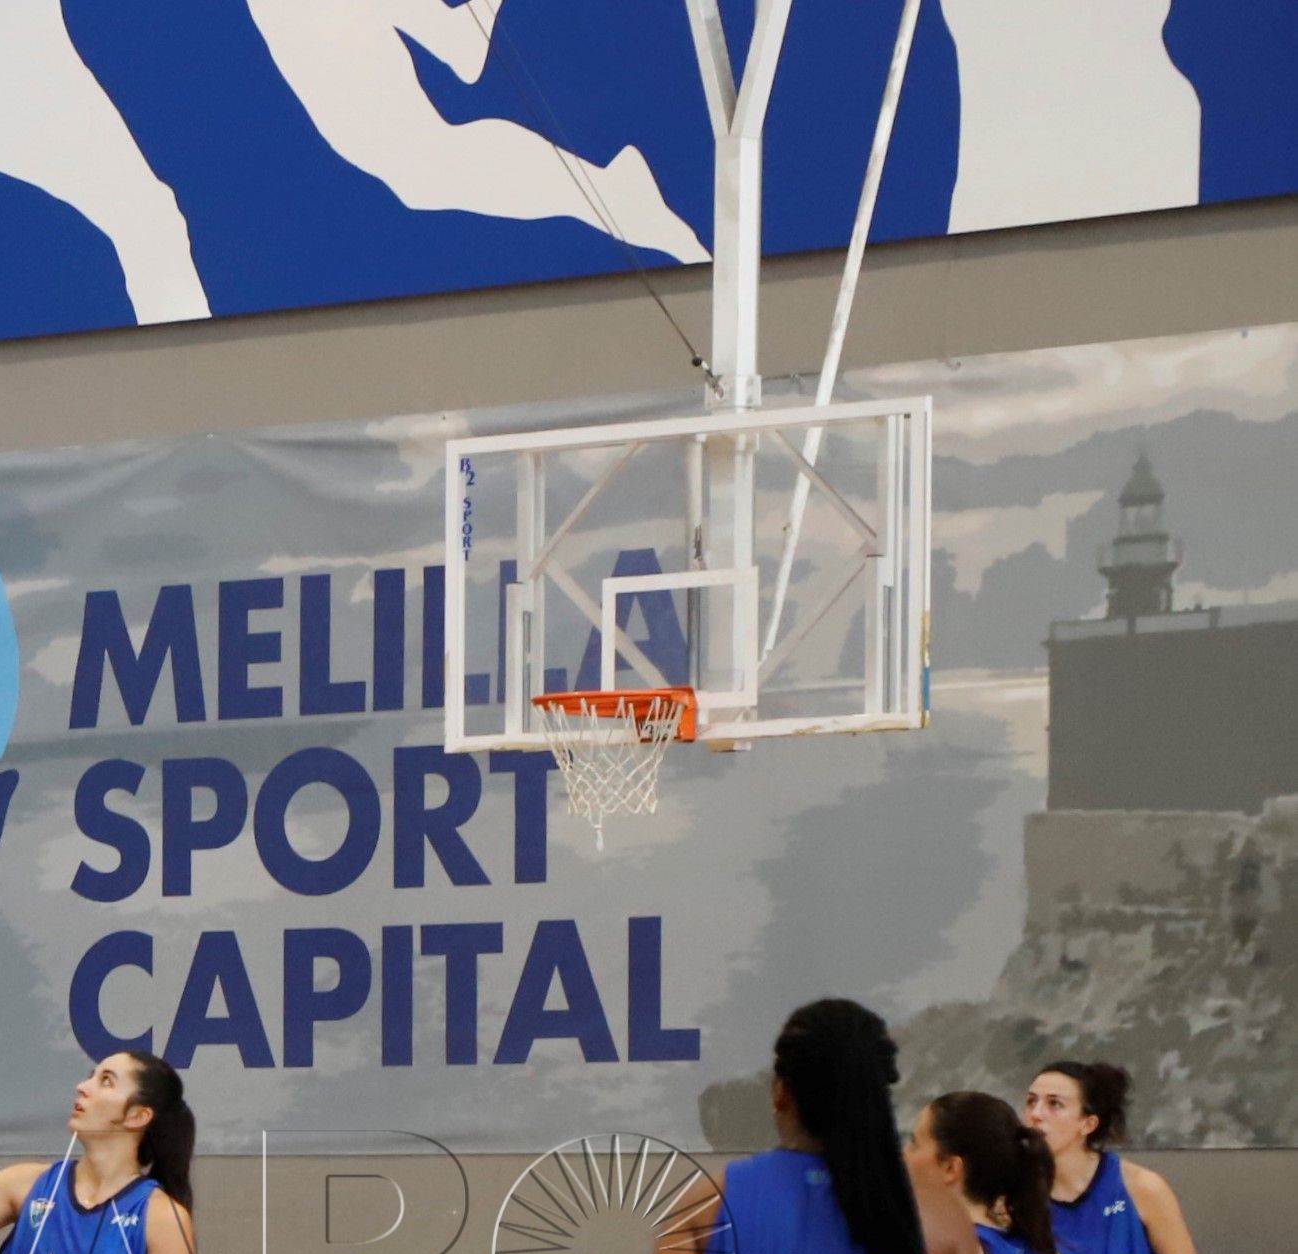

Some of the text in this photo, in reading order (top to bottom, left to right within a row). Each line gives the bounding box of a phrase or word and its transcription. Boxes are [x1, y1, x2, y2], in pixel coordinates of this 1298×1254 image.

[462, 497, 472, 561] SPORT
[70, 746, 573, 902] SPORT
[68, 916, 700, 1069] CAPITAL
